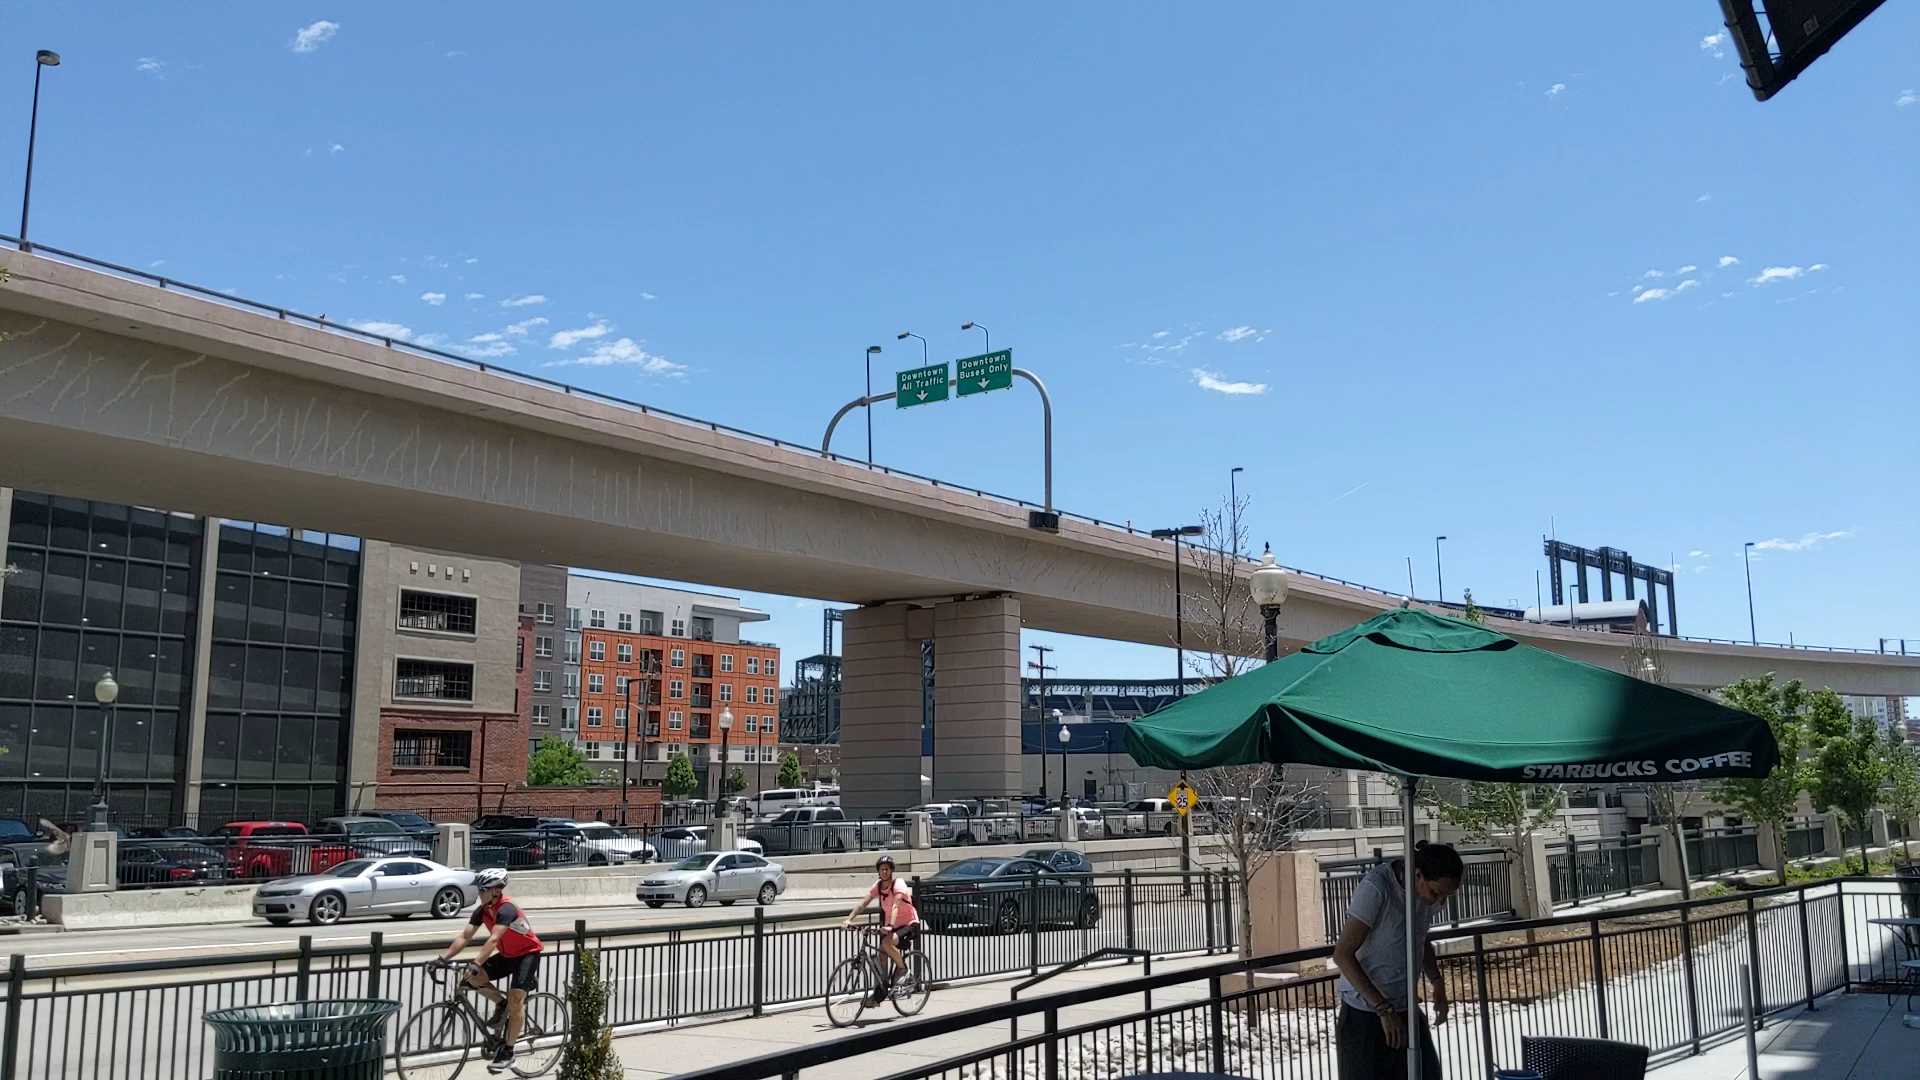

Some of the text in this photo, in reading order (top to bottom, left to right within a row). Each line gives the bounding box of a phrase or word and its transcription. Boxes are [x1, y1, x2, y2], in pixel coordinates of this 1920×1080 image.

[962, 354, 1006, 369] Downtown
[901, 368, 944, 382] Downtown
[960, 363, 1008, 379] Buses Only
[902, 377, 944, 391] All Traffic
[1521, 751, 1752, 779] STARBUCKS COFFEE
[1177, 797, 1188, 808] 25
